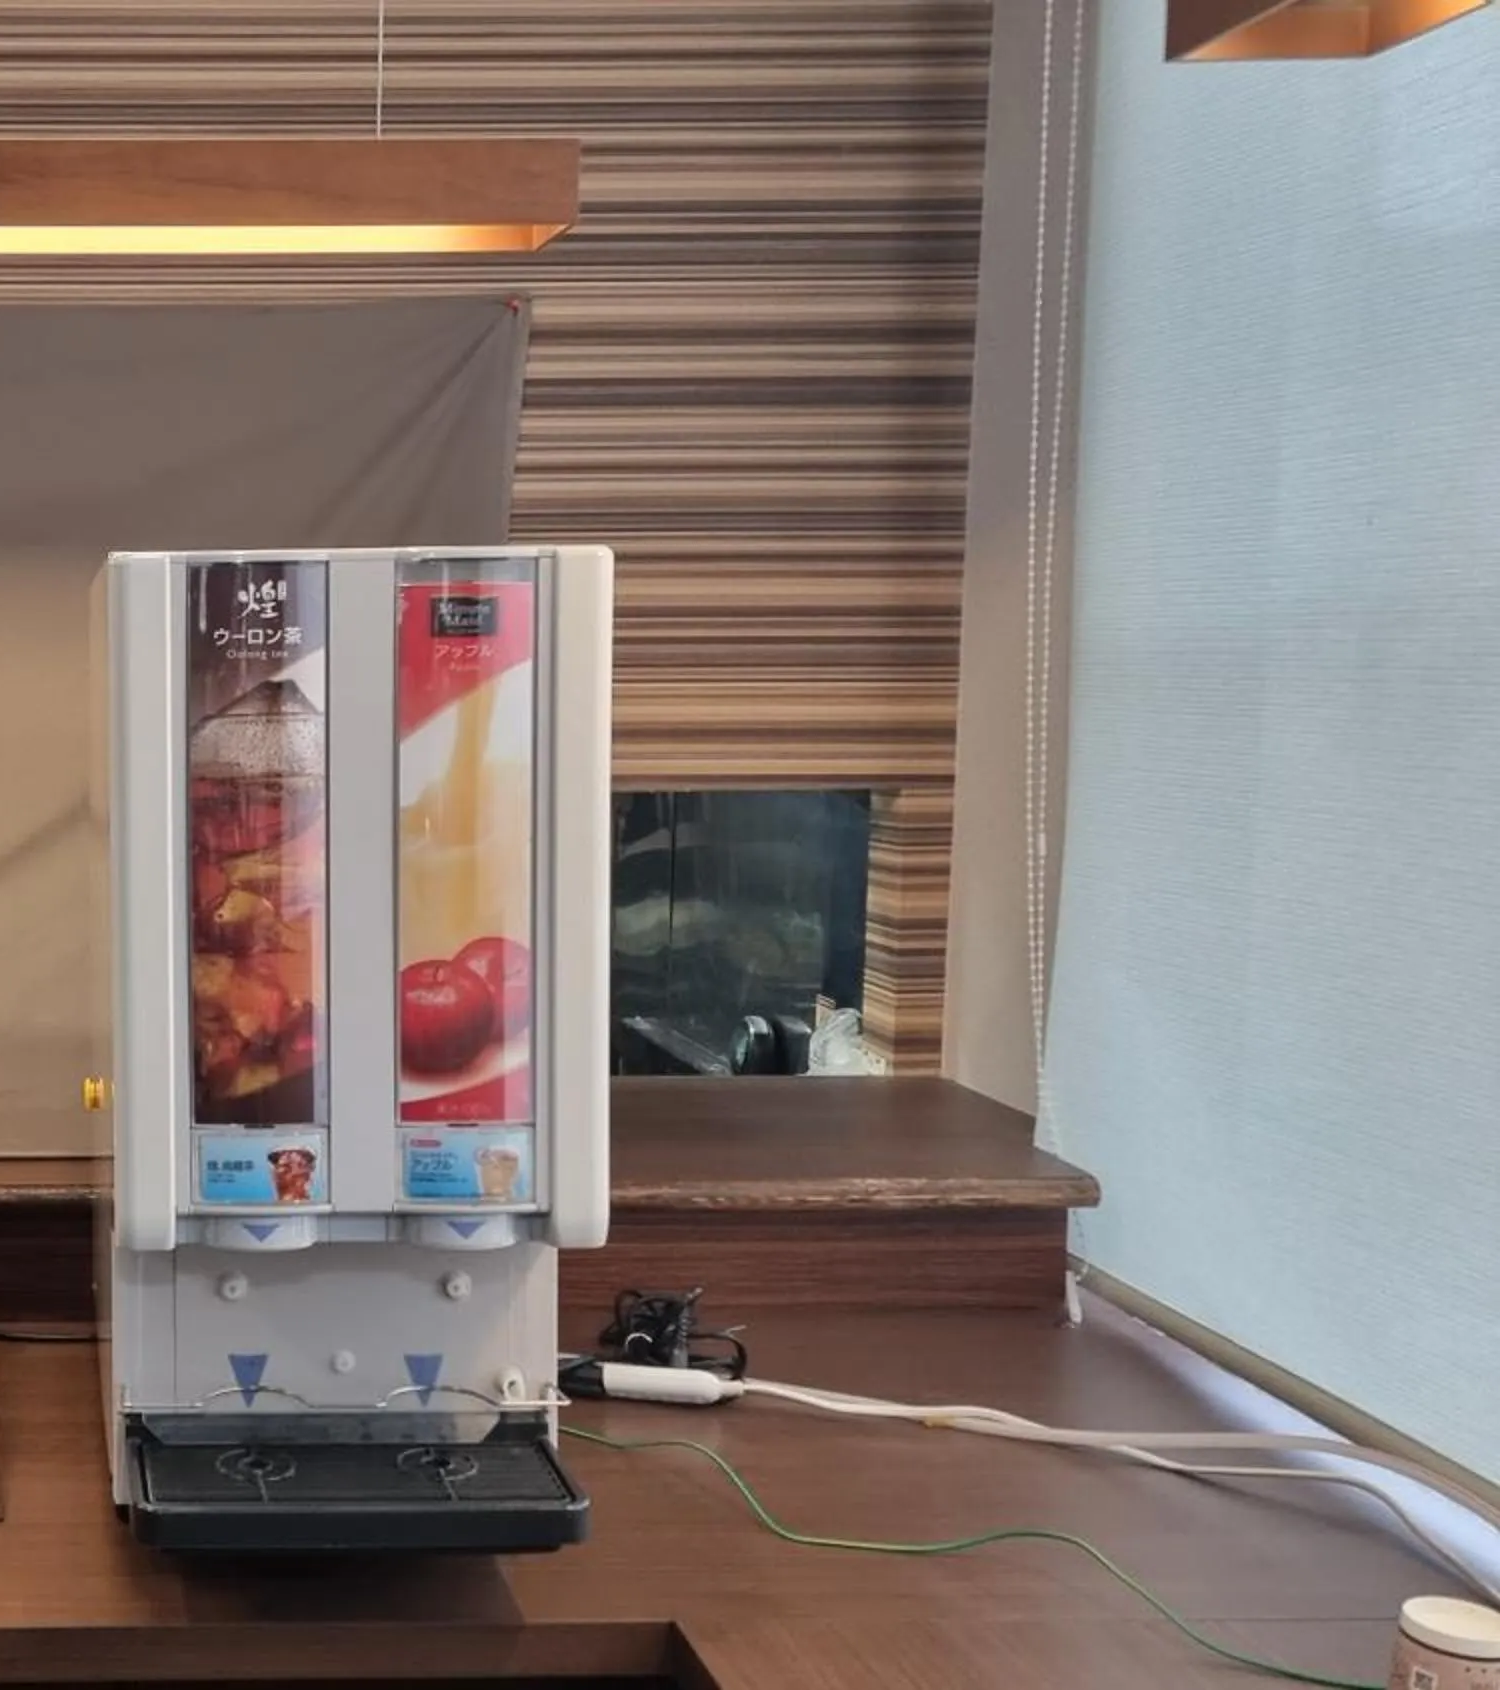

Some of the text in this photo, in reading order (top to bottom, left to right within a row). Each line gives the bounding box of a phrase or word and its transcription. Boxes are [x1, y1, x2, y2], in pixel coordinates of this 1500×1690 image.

[213, 627, 302, 646] ウーロン茶
